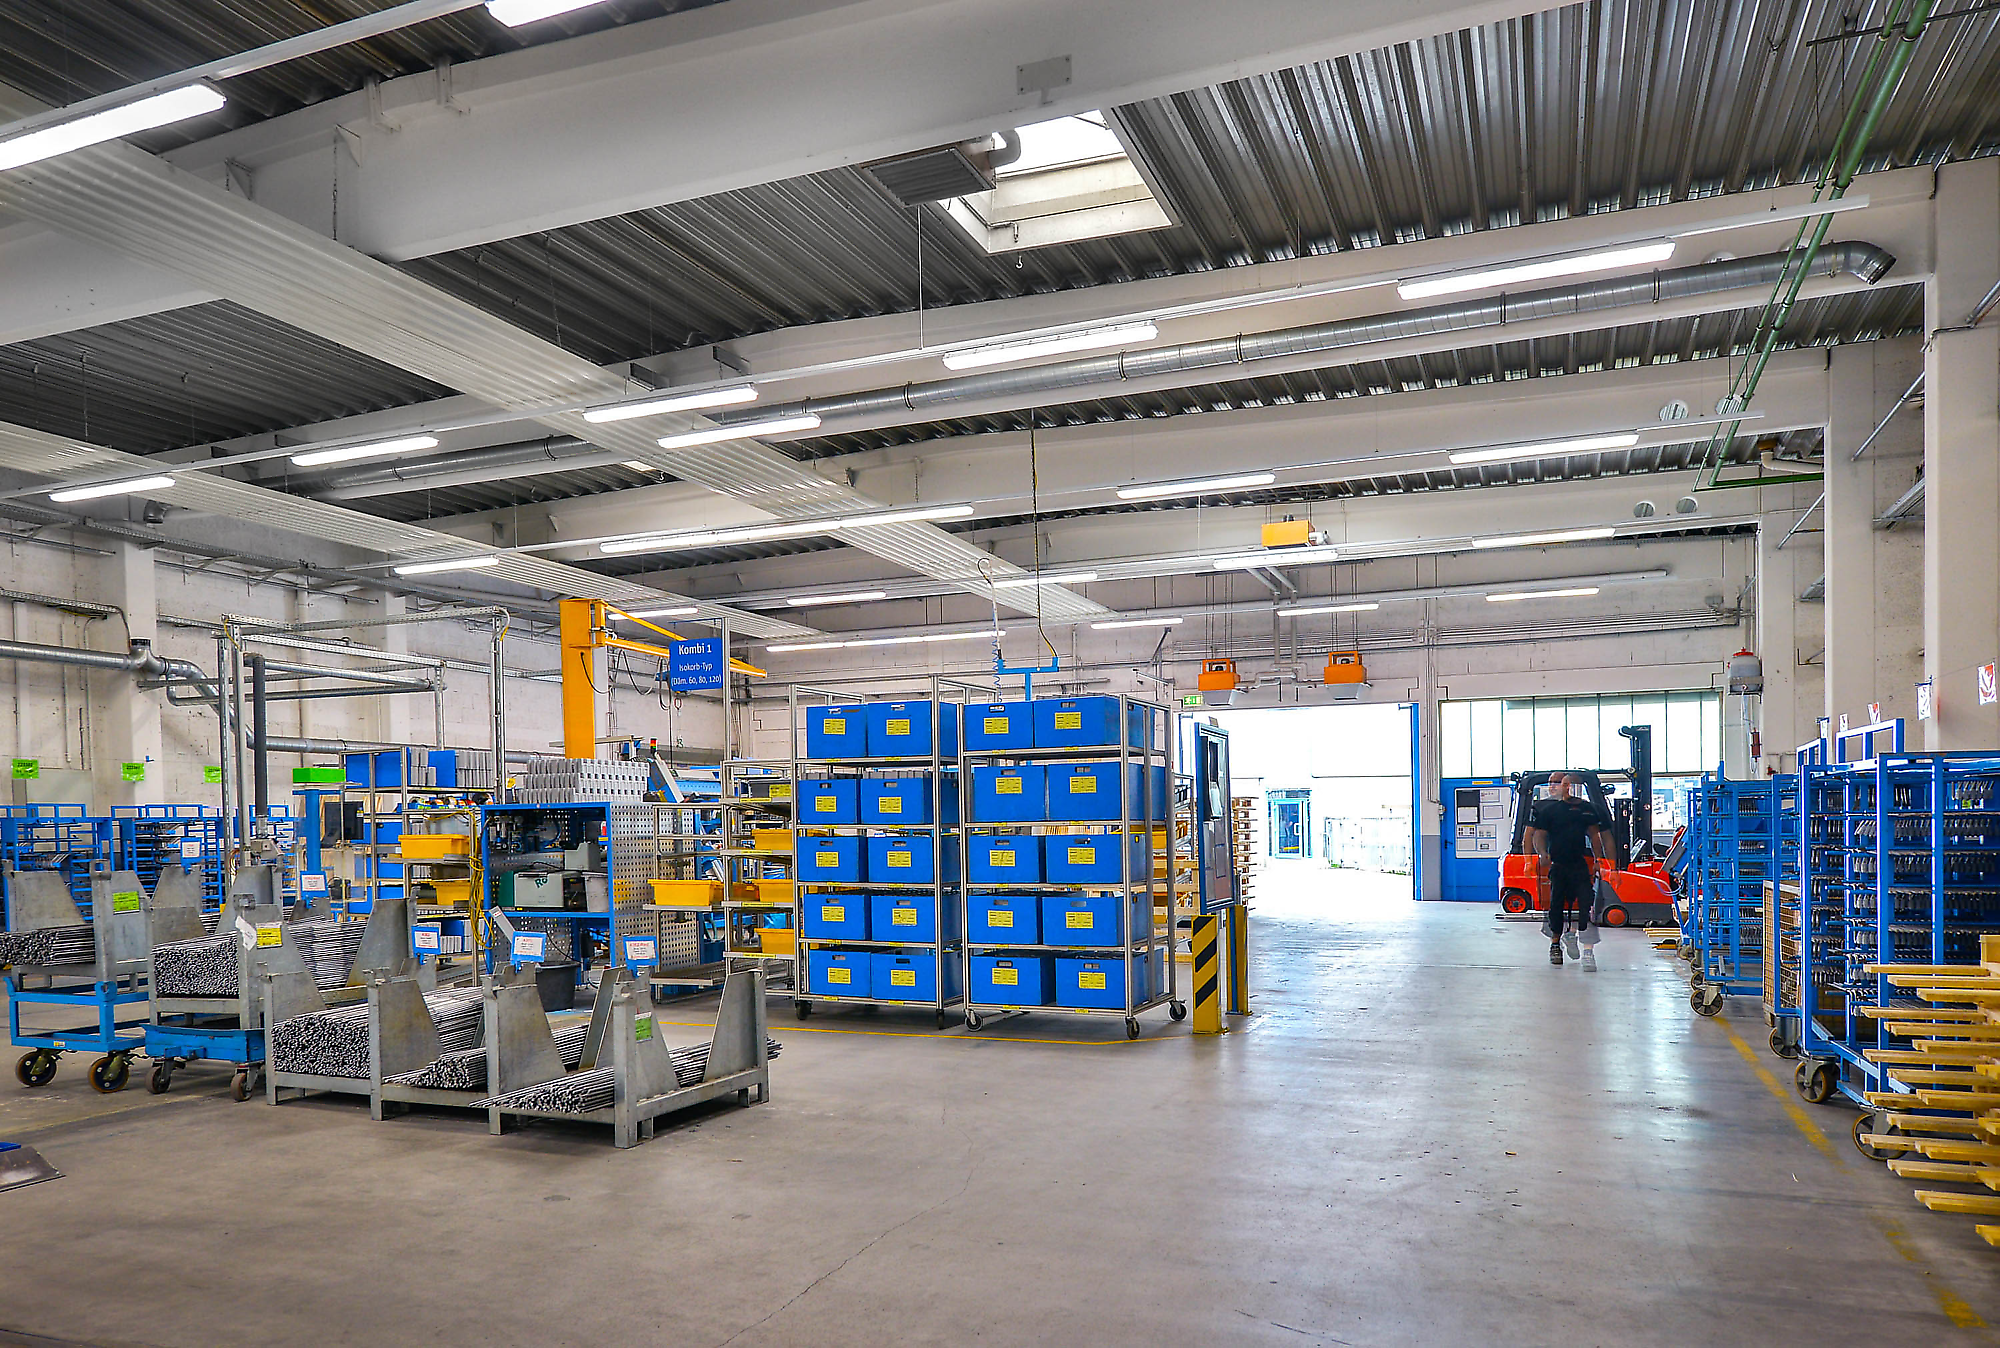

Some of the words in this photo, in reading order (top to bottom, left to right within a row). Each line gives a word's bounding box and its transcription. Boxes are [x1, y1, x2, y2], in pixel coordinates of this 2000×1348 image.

[679, 643, 705, 655] Kombi
[707, 644, 712, 653] 1
[709, 674, 722, 683] 120)
